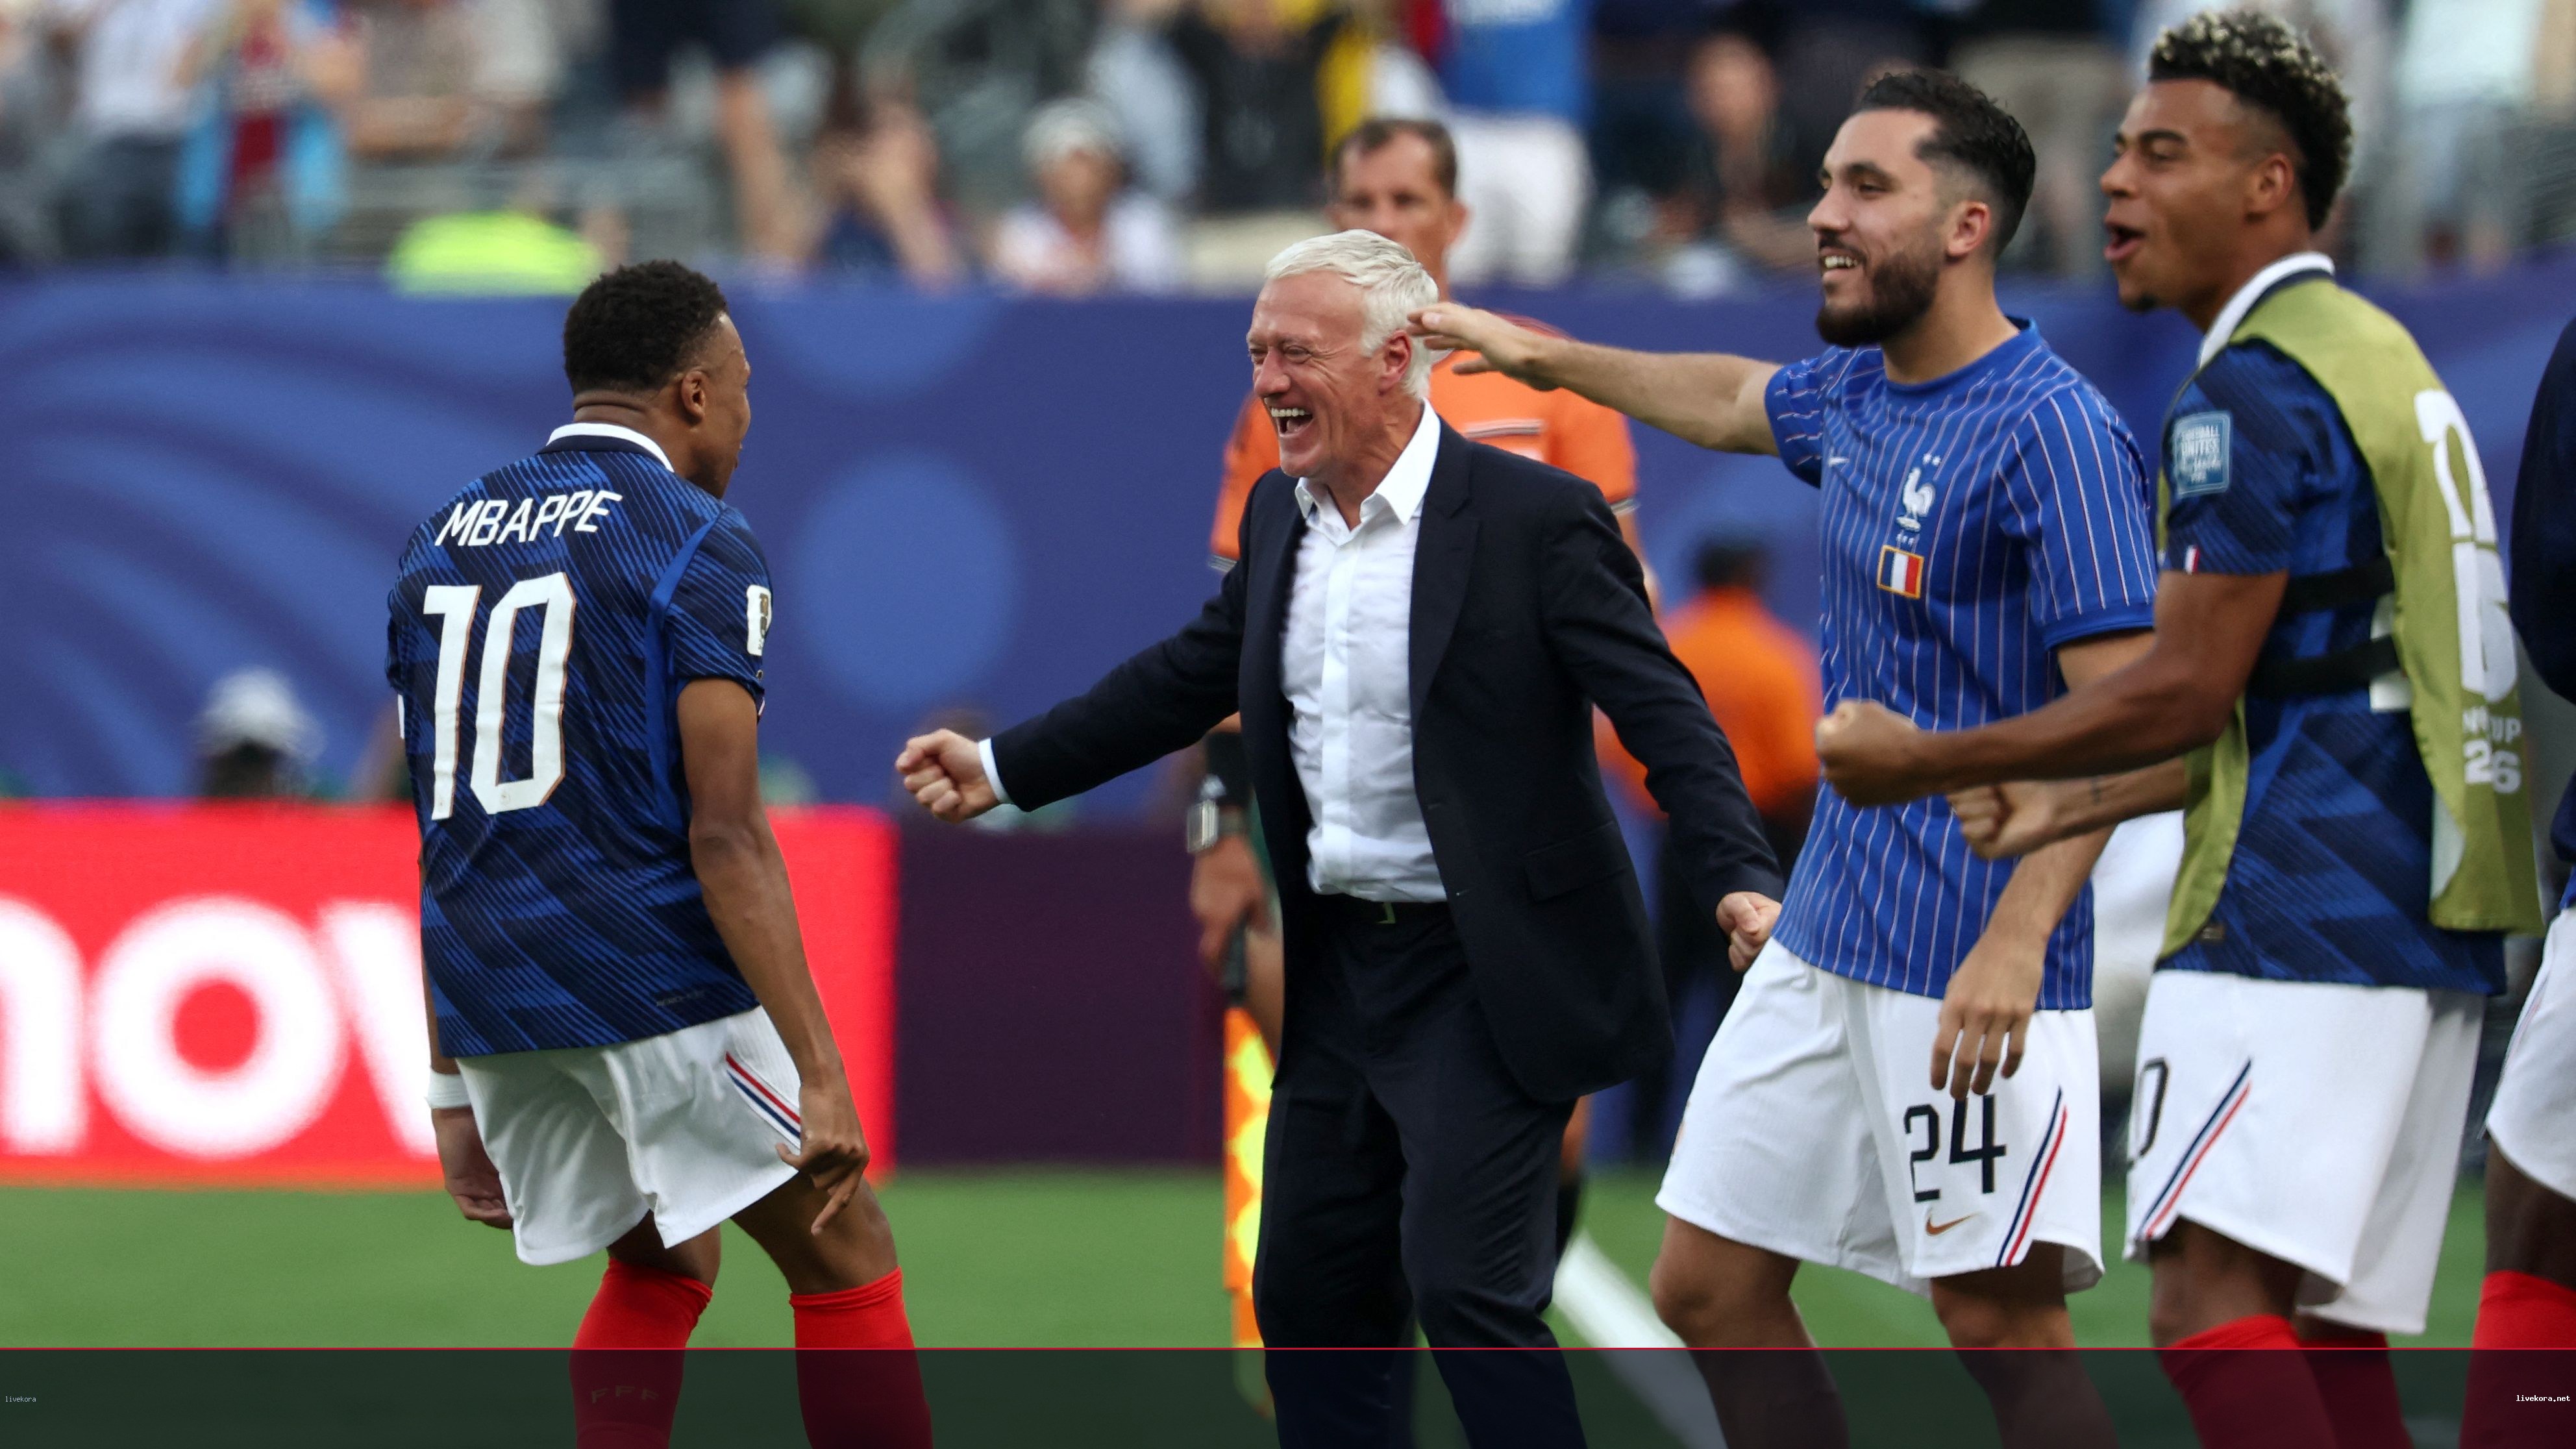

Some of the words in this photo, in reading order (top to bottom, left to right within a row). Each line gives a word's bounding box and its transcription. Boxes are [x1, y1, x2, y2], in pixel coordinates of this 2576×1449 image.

[435, 489, 623, 547] MBAPPE
[423, 571, 576, 821] 10
[2464, 739, 2522, 793] 26
[1903, 1093, 2007, 1202] 24
[591, 1384, 660, 1404] FFF
